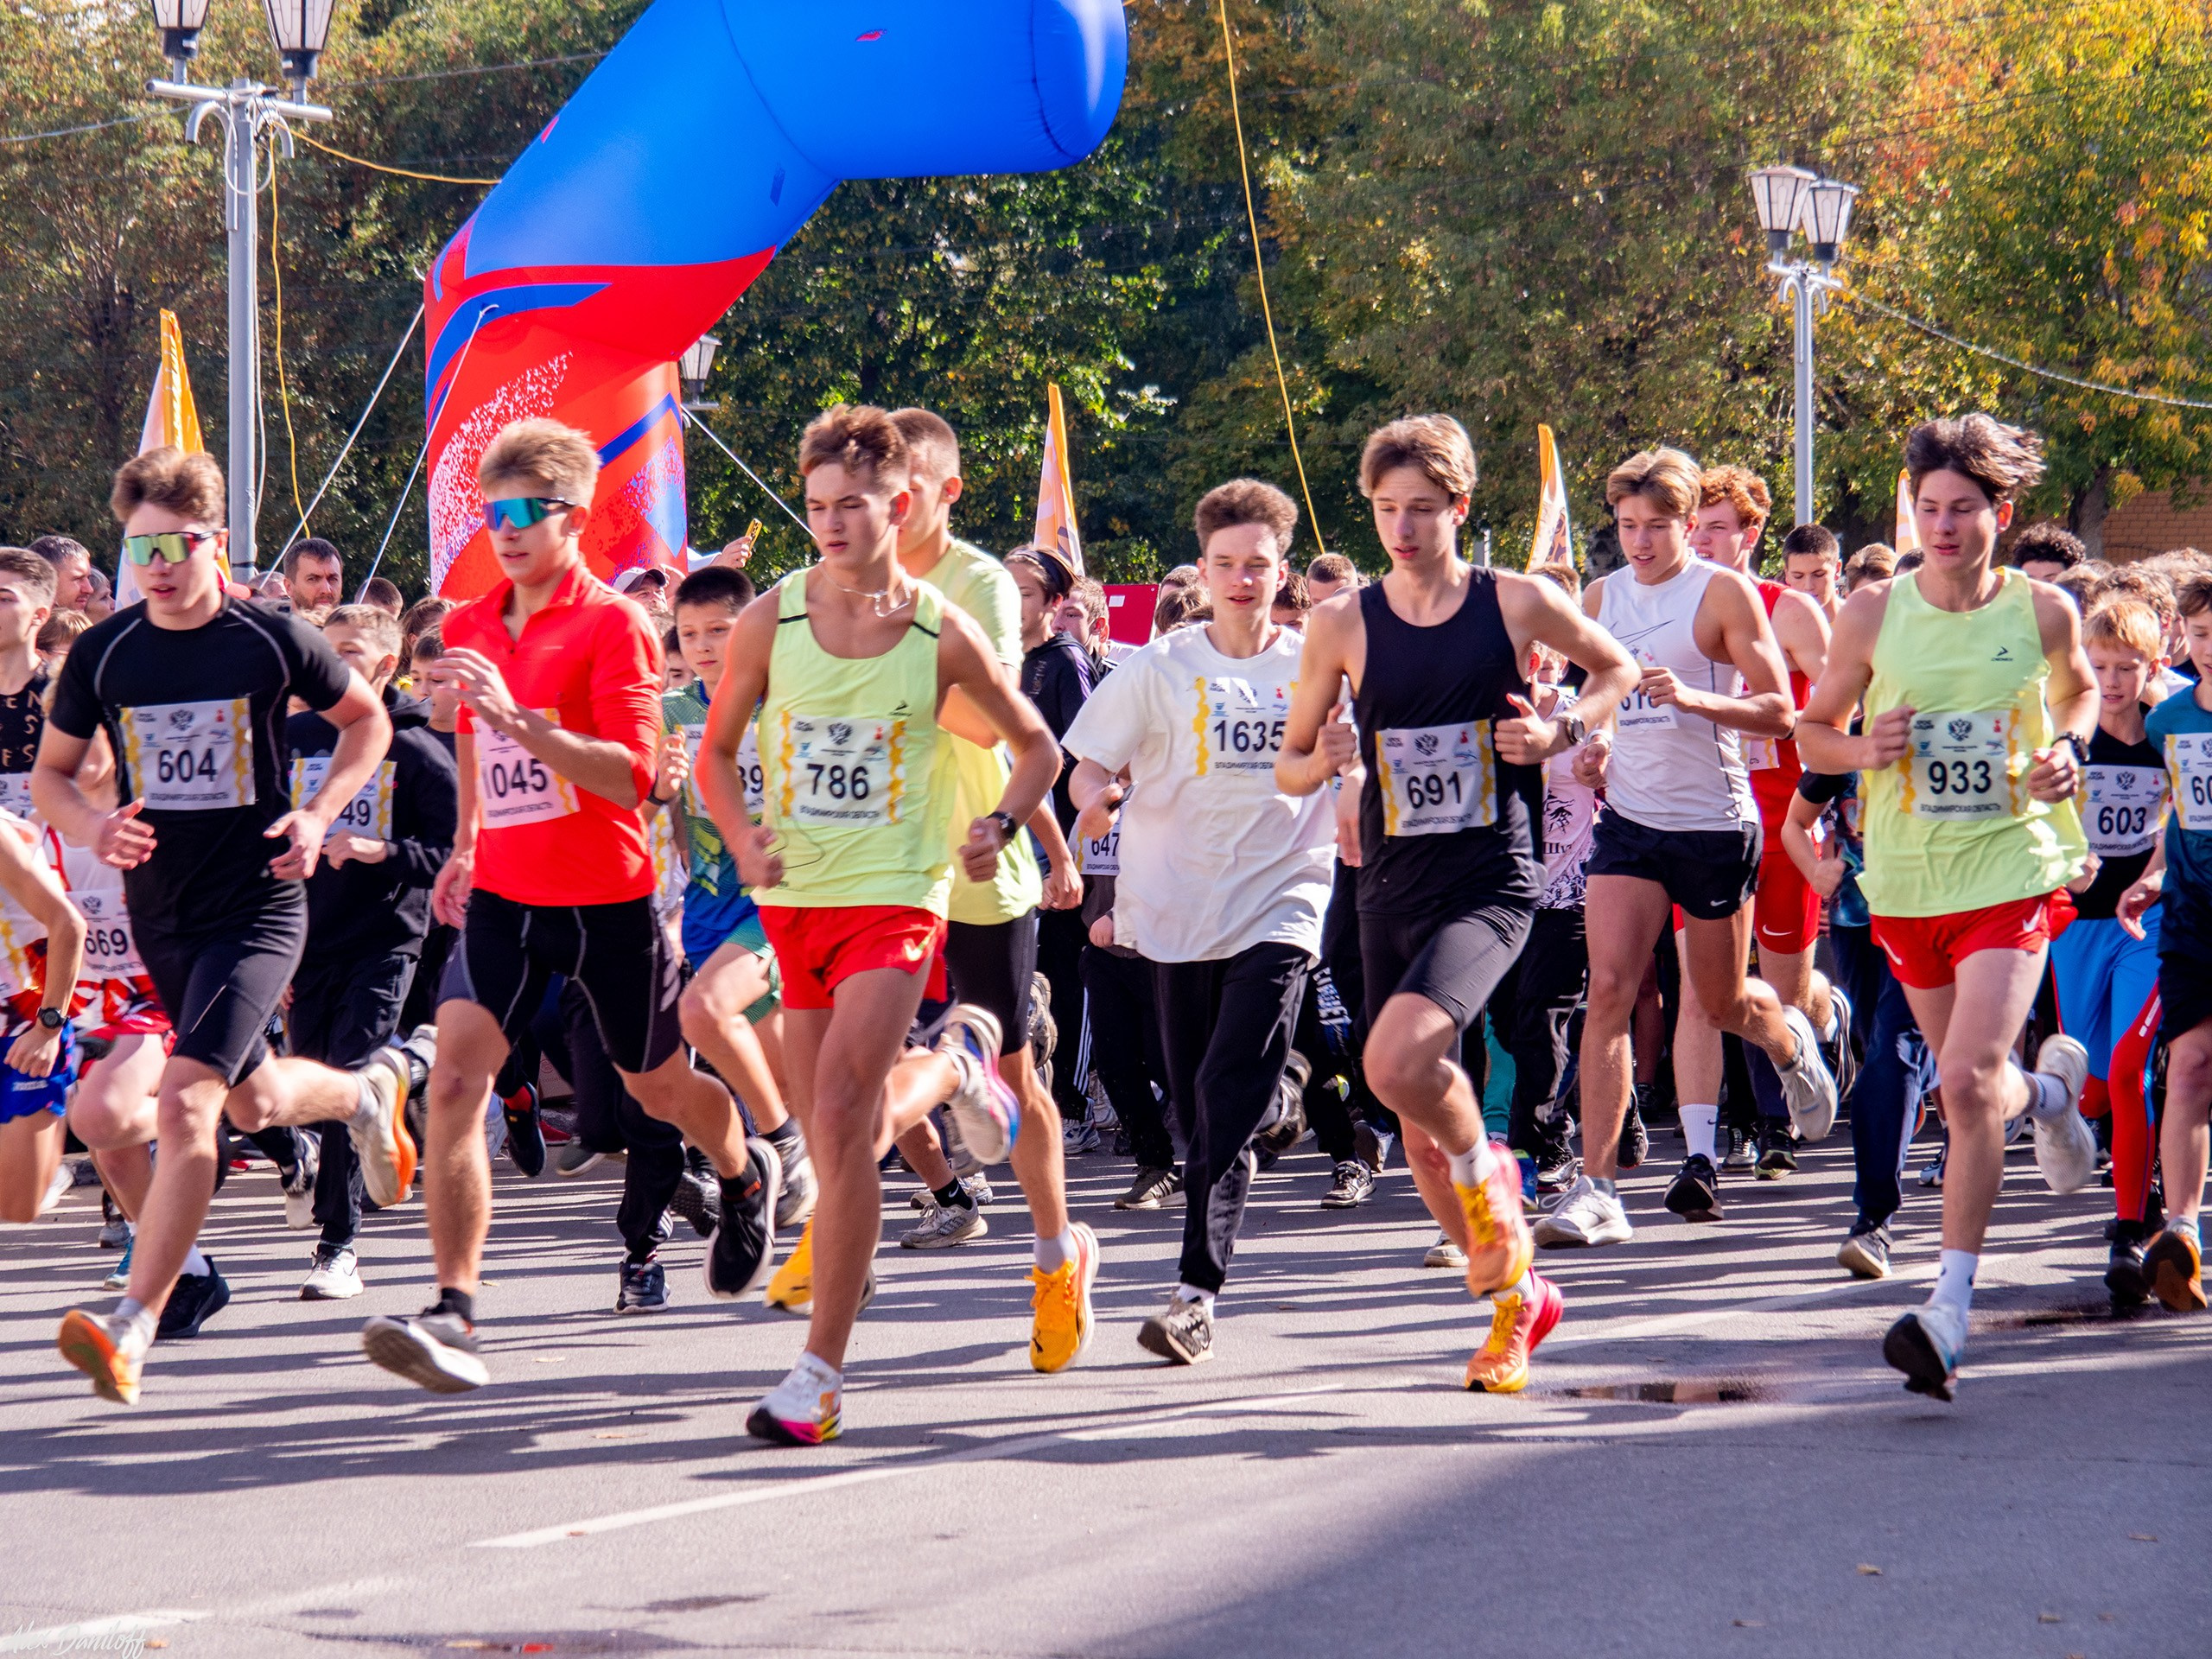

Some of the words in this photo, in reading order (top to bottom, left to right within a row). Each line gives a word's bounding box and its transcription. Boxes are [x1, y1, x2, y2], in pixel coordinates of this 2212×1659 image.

[1214, 720, 1287, 752] 1635
[159, 747, 218, 784] 604
[1928, 760, 1992, 795] 933
[806, 763, 870, 801] 786
[1407, 771, 1462, 810] 691
[340, 799, 372, 827] 49
[2098, 806, 2146, 836] 603
[1091, 832, 1120, 856] 647
[85, 928, 129, 957] 669
